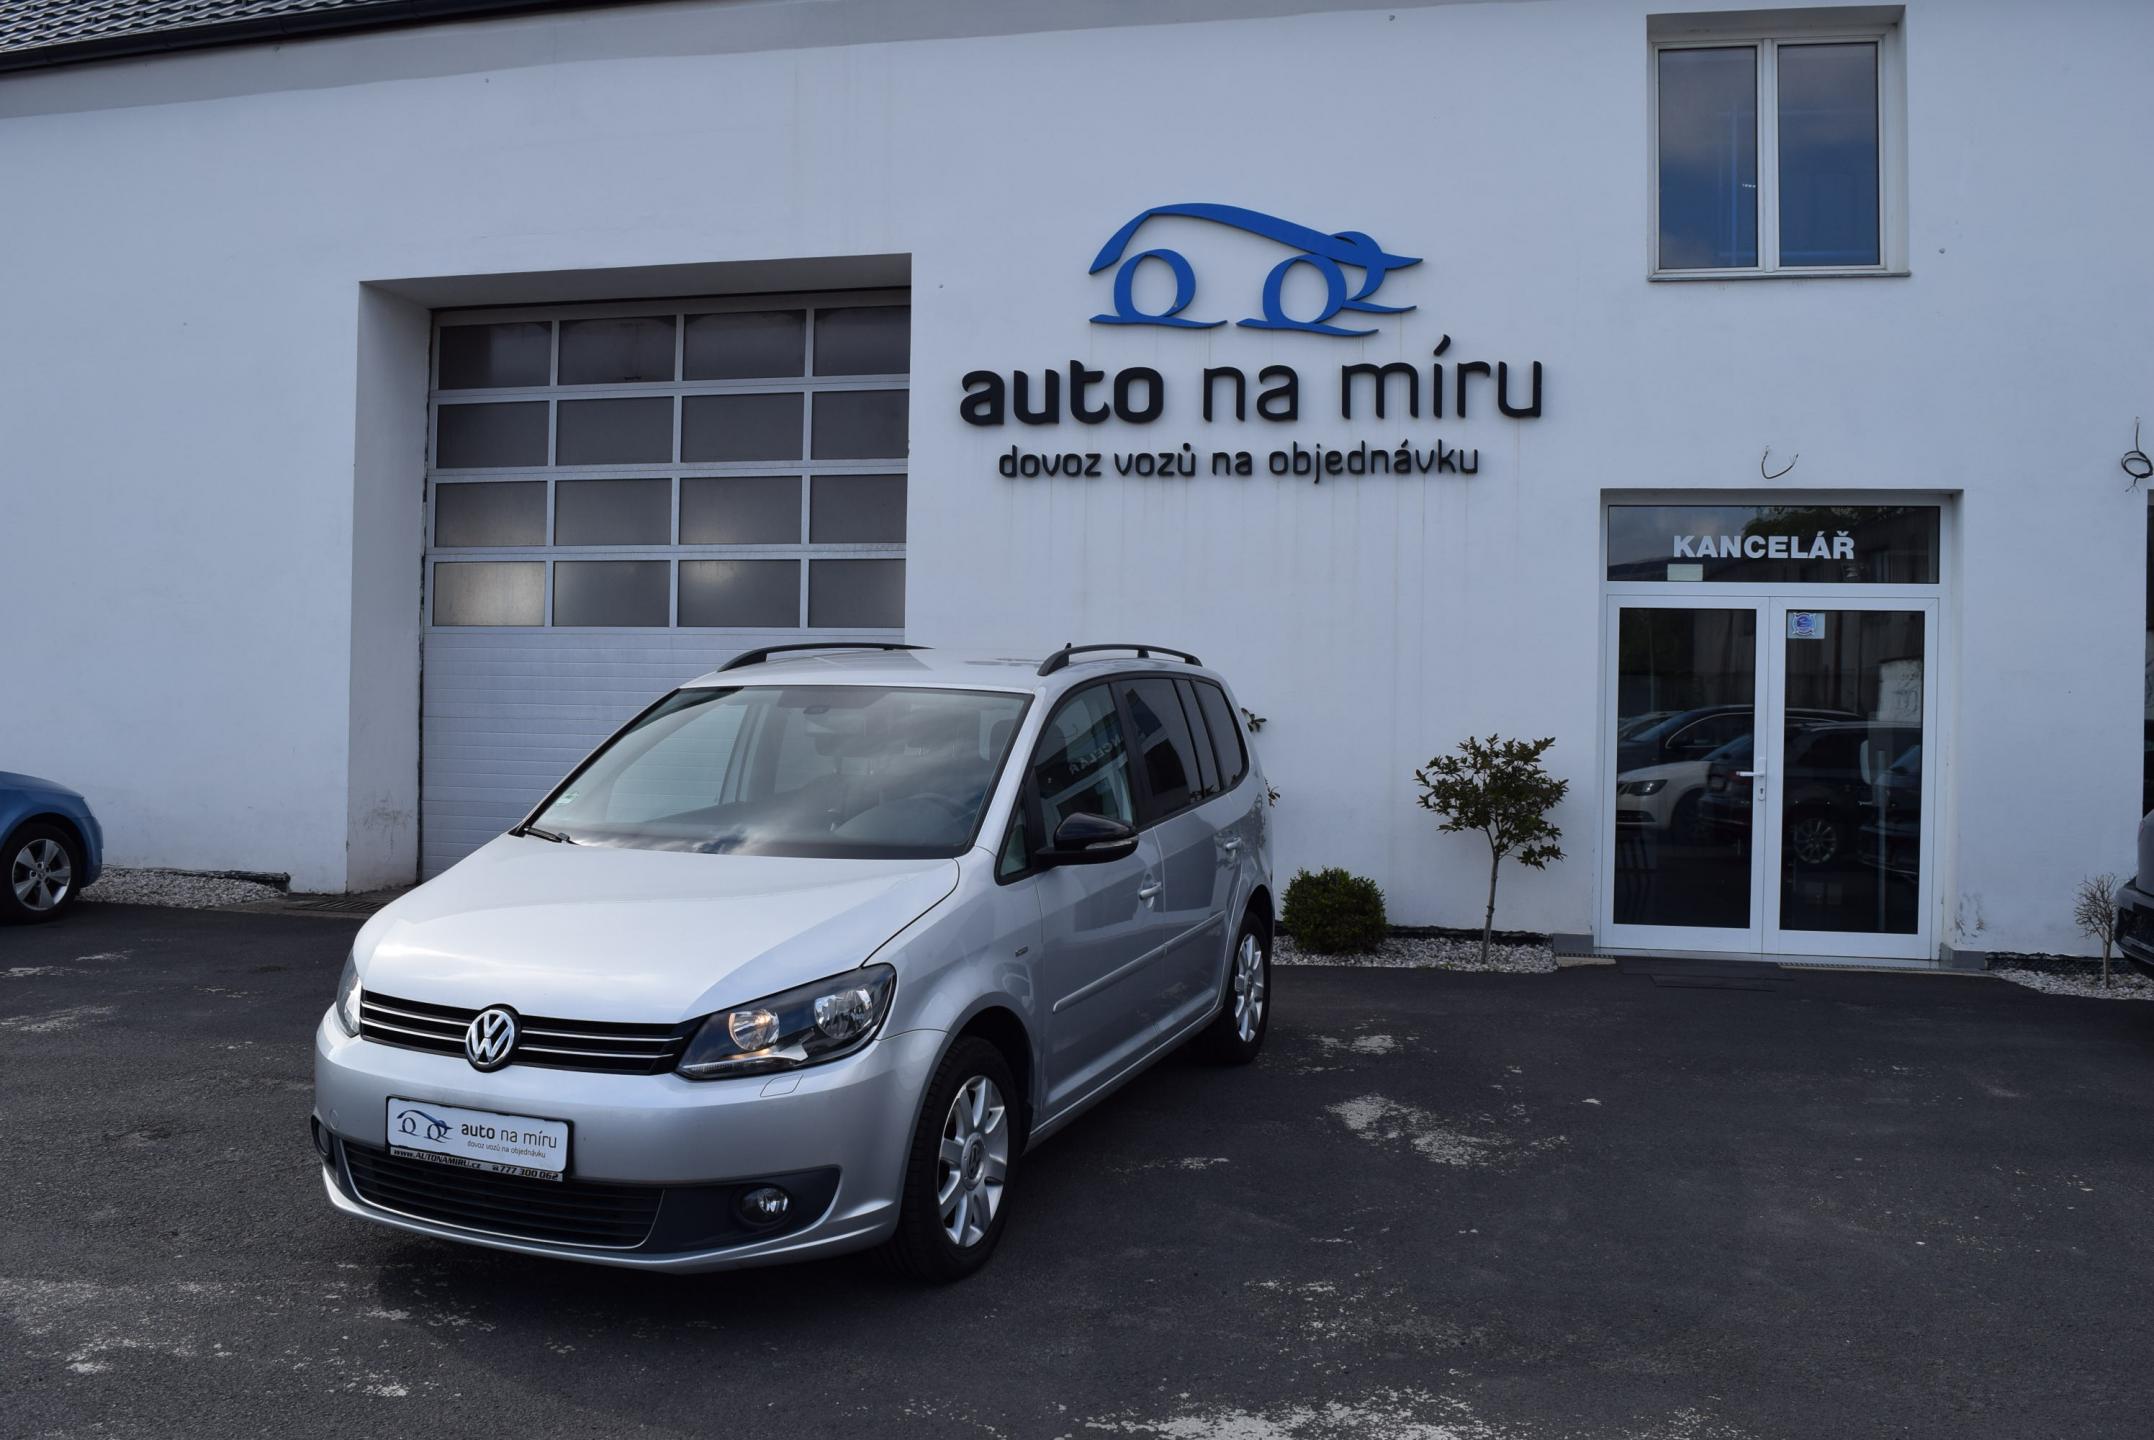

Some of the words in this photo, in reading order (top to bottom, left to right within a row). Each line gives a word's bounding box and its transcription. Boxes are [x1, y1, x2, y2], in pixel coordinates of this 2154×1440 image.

[960, 360, 1164, 425] auto
[1203, 365, 1298, 423] na
[1341, 334, 1543, 420] míru
[999, 445, 1101, 478] dovoz
[1115, 443, 1196, 478] vozů
[1212, 452, 1252, 476] na
[1269, 439, 1478, 484] objednávku
[1674, 531, 1854, 559] KANCELÁŘ
[461, 1123, 495, 1140] auto
[501, 1130, 518, 1143] na
[523, 1130, 557, 1149] míru
[467, 1140, 485, 1149] dovoz
[501, 1146, 510, 1154] na
